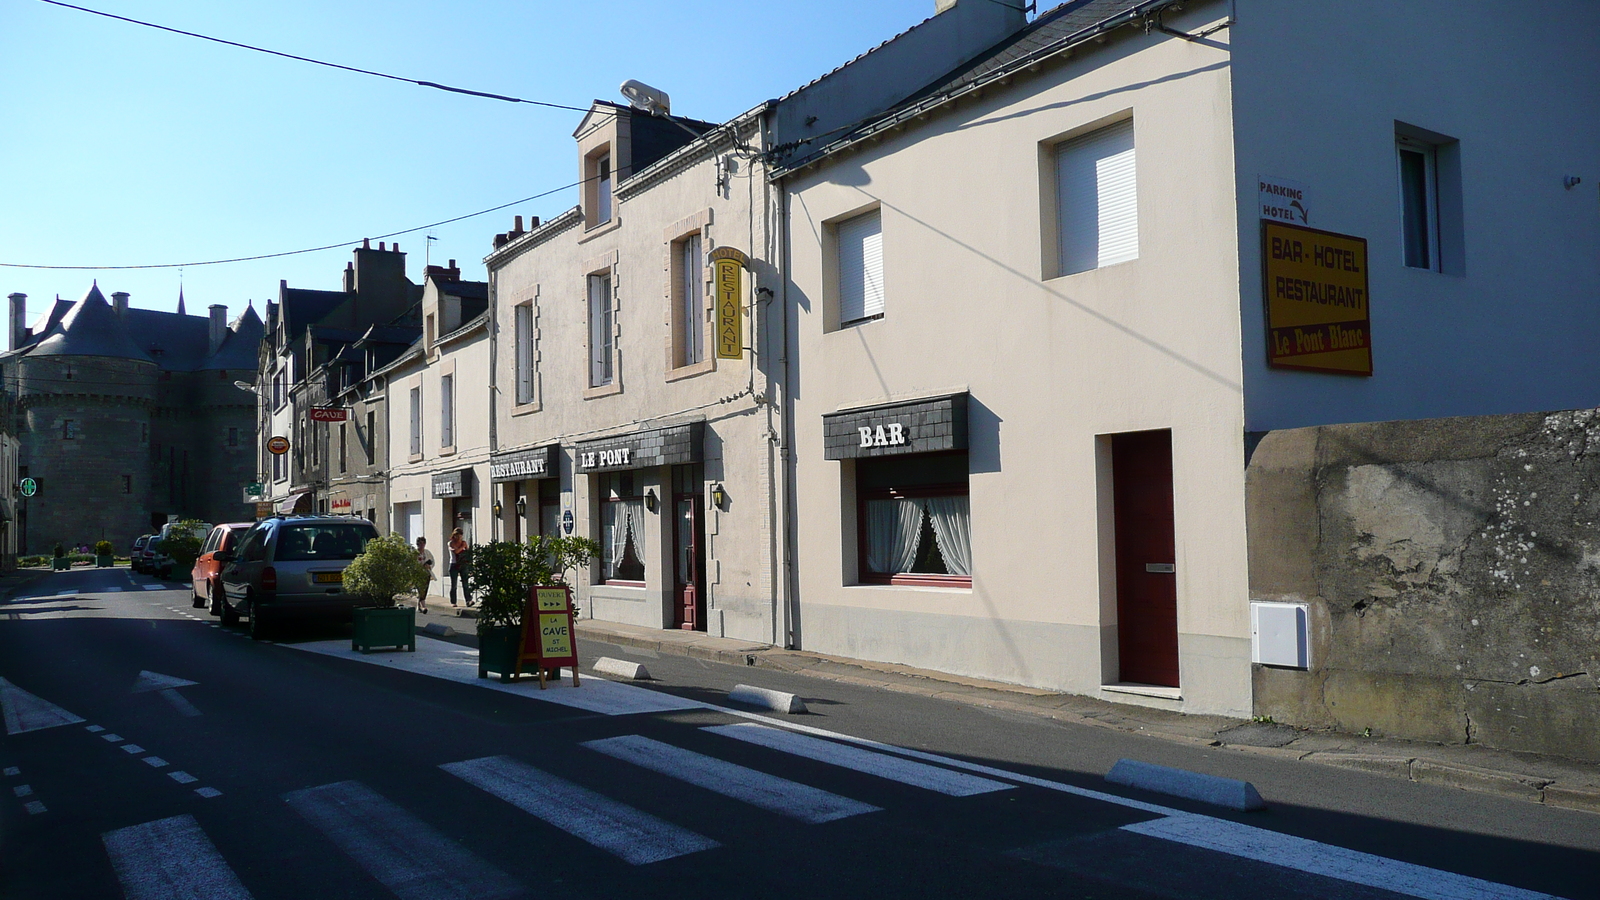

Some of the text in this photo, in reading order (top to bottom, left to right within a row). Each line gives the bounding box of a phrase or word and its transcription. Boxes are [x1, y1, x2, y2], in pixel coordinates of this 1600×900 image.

[1260, 181, 1303, 200] PARKING
[1263, 204, 1295, 221] HOTEL
[711, 248, 746, 263] HOTEL
[1271, 236, 1303, 263] BAR
[1314, 244, 1360, 273] HOTEL
[1276, 275, 1363, 310] RESTAURANT
[722, 265, 737, 353] RESTAURANT
[1273, 325, 1365, 356] Le Pont Blanc
[314, 410, 344, 419] CAVE
[858, 422, 905, 449] BAR
[581, 447, 630, 468] LE PONT
[490, 458, 545, 479] RESTAURANT
[542, 626, 567, 636] CAVE
